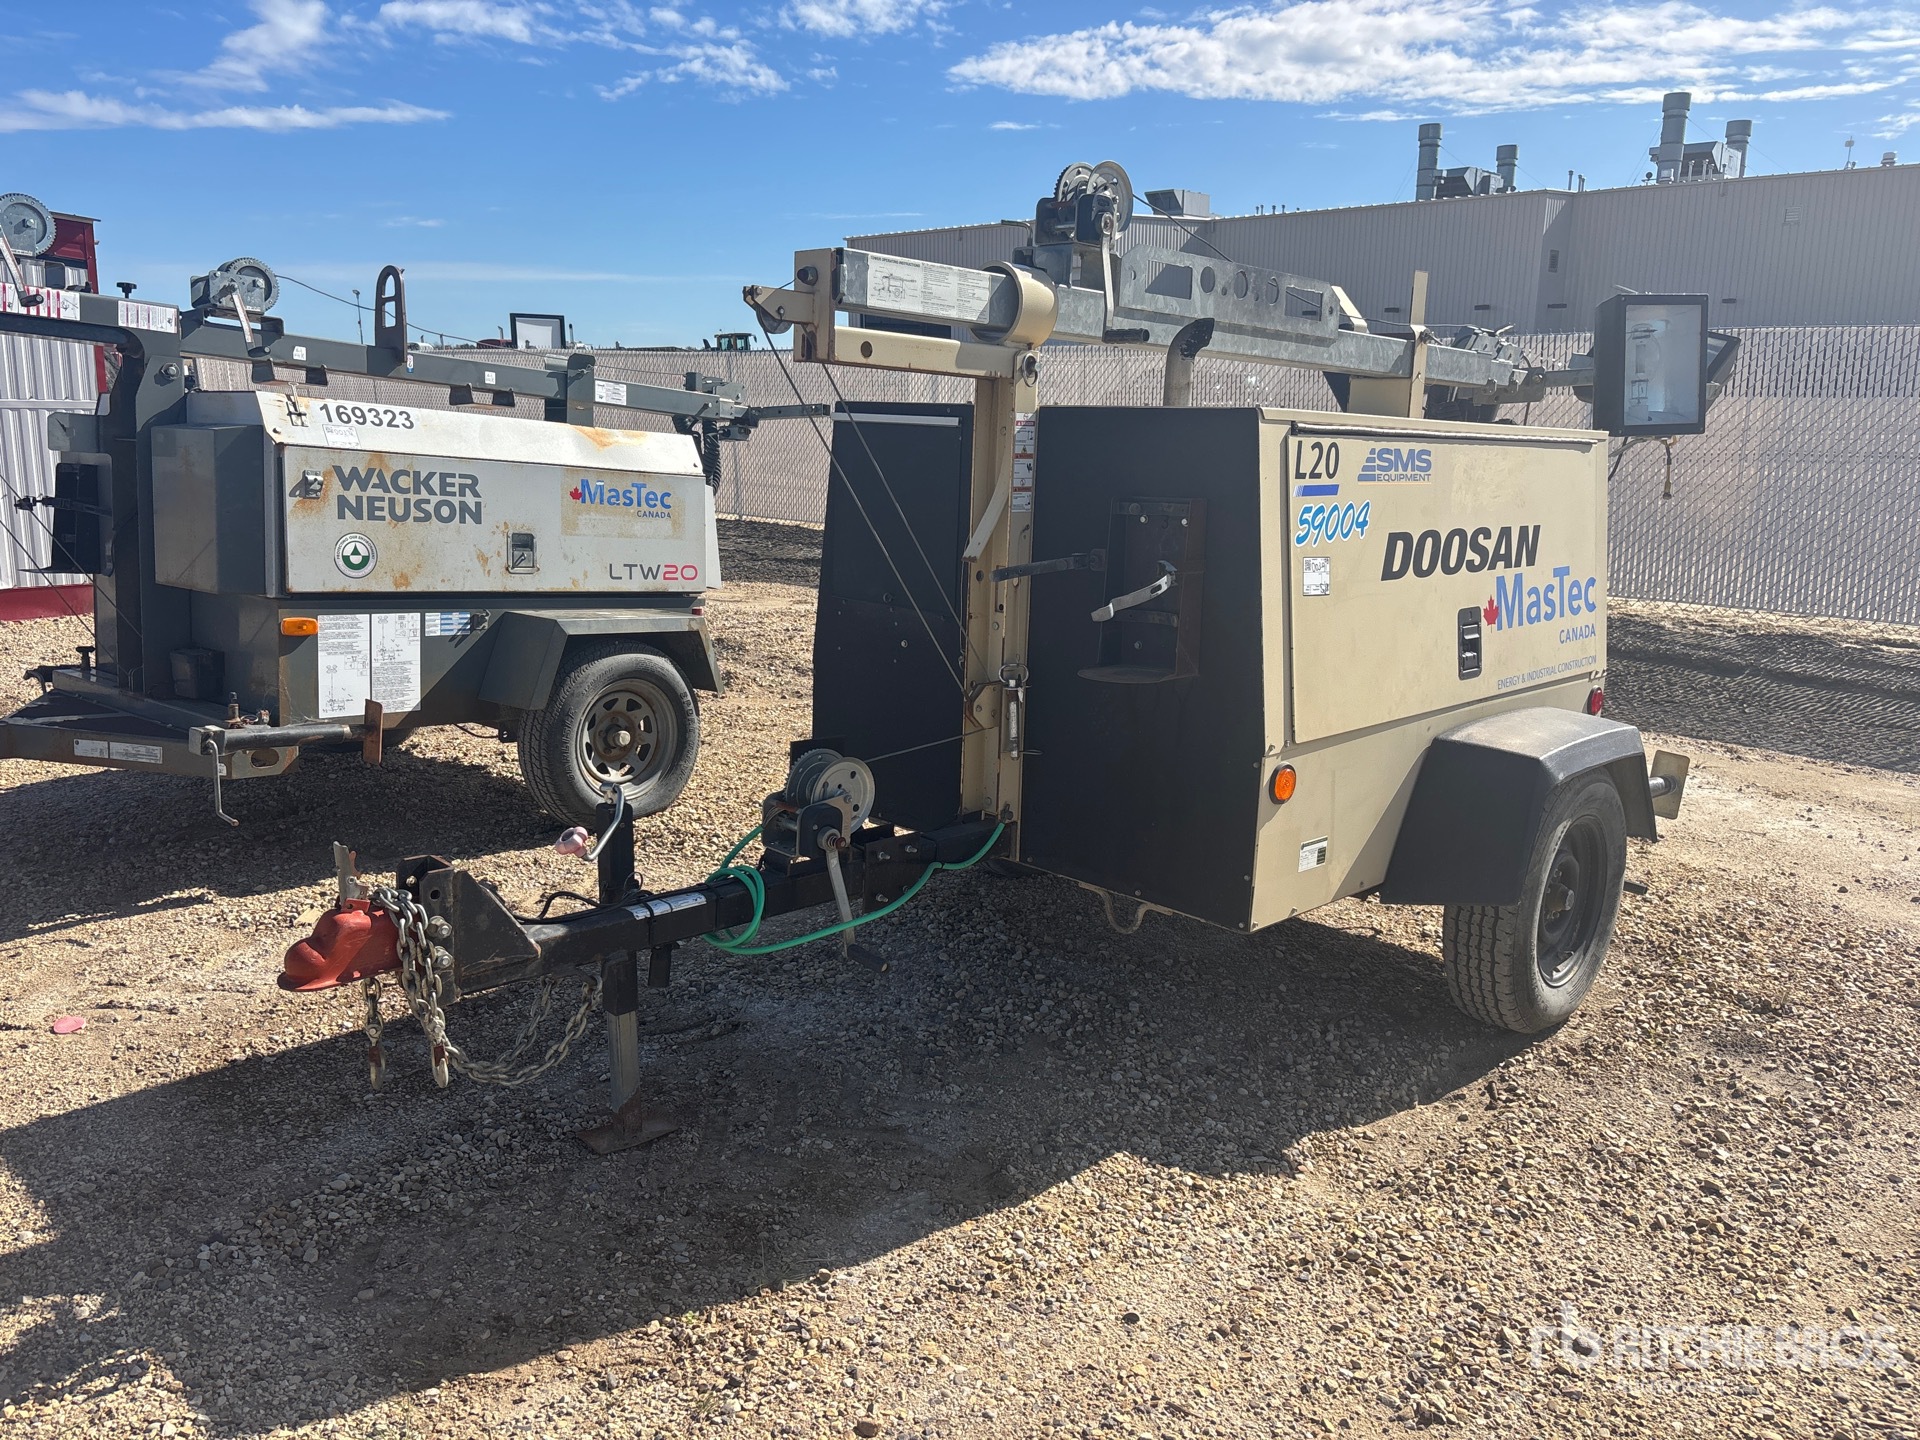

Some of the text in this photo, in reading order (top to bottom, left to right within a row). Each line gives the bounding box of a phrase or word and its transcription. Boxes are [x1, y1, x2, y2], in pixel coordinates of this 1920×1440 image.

[320, 403, 415, 429] 169323
[1295, 440, 1340, 479] L20
[1376, 448, 1432, 473] SMS
[332, 465, 482, 498] WACKER
[1376, 474, 1432, 482] EQUIPMENT
[580, 479, 672, 509] MasTec
[337, 495, 482, 524] NEUSON
[636, 510, 672, 519] CANADA
[1295, 500, 1371, 547] 59004
[1381, 525, 1541, 581] DOOSAN
[609, 563, 699, 580] LTW20
[1496, 565, 1597, 631] MasTec
[1559, 623, 1597, 645] CANADA
[1497, 655, 1597, 690] ENERGY & INDUSTRIAL CONSTRUCTION
